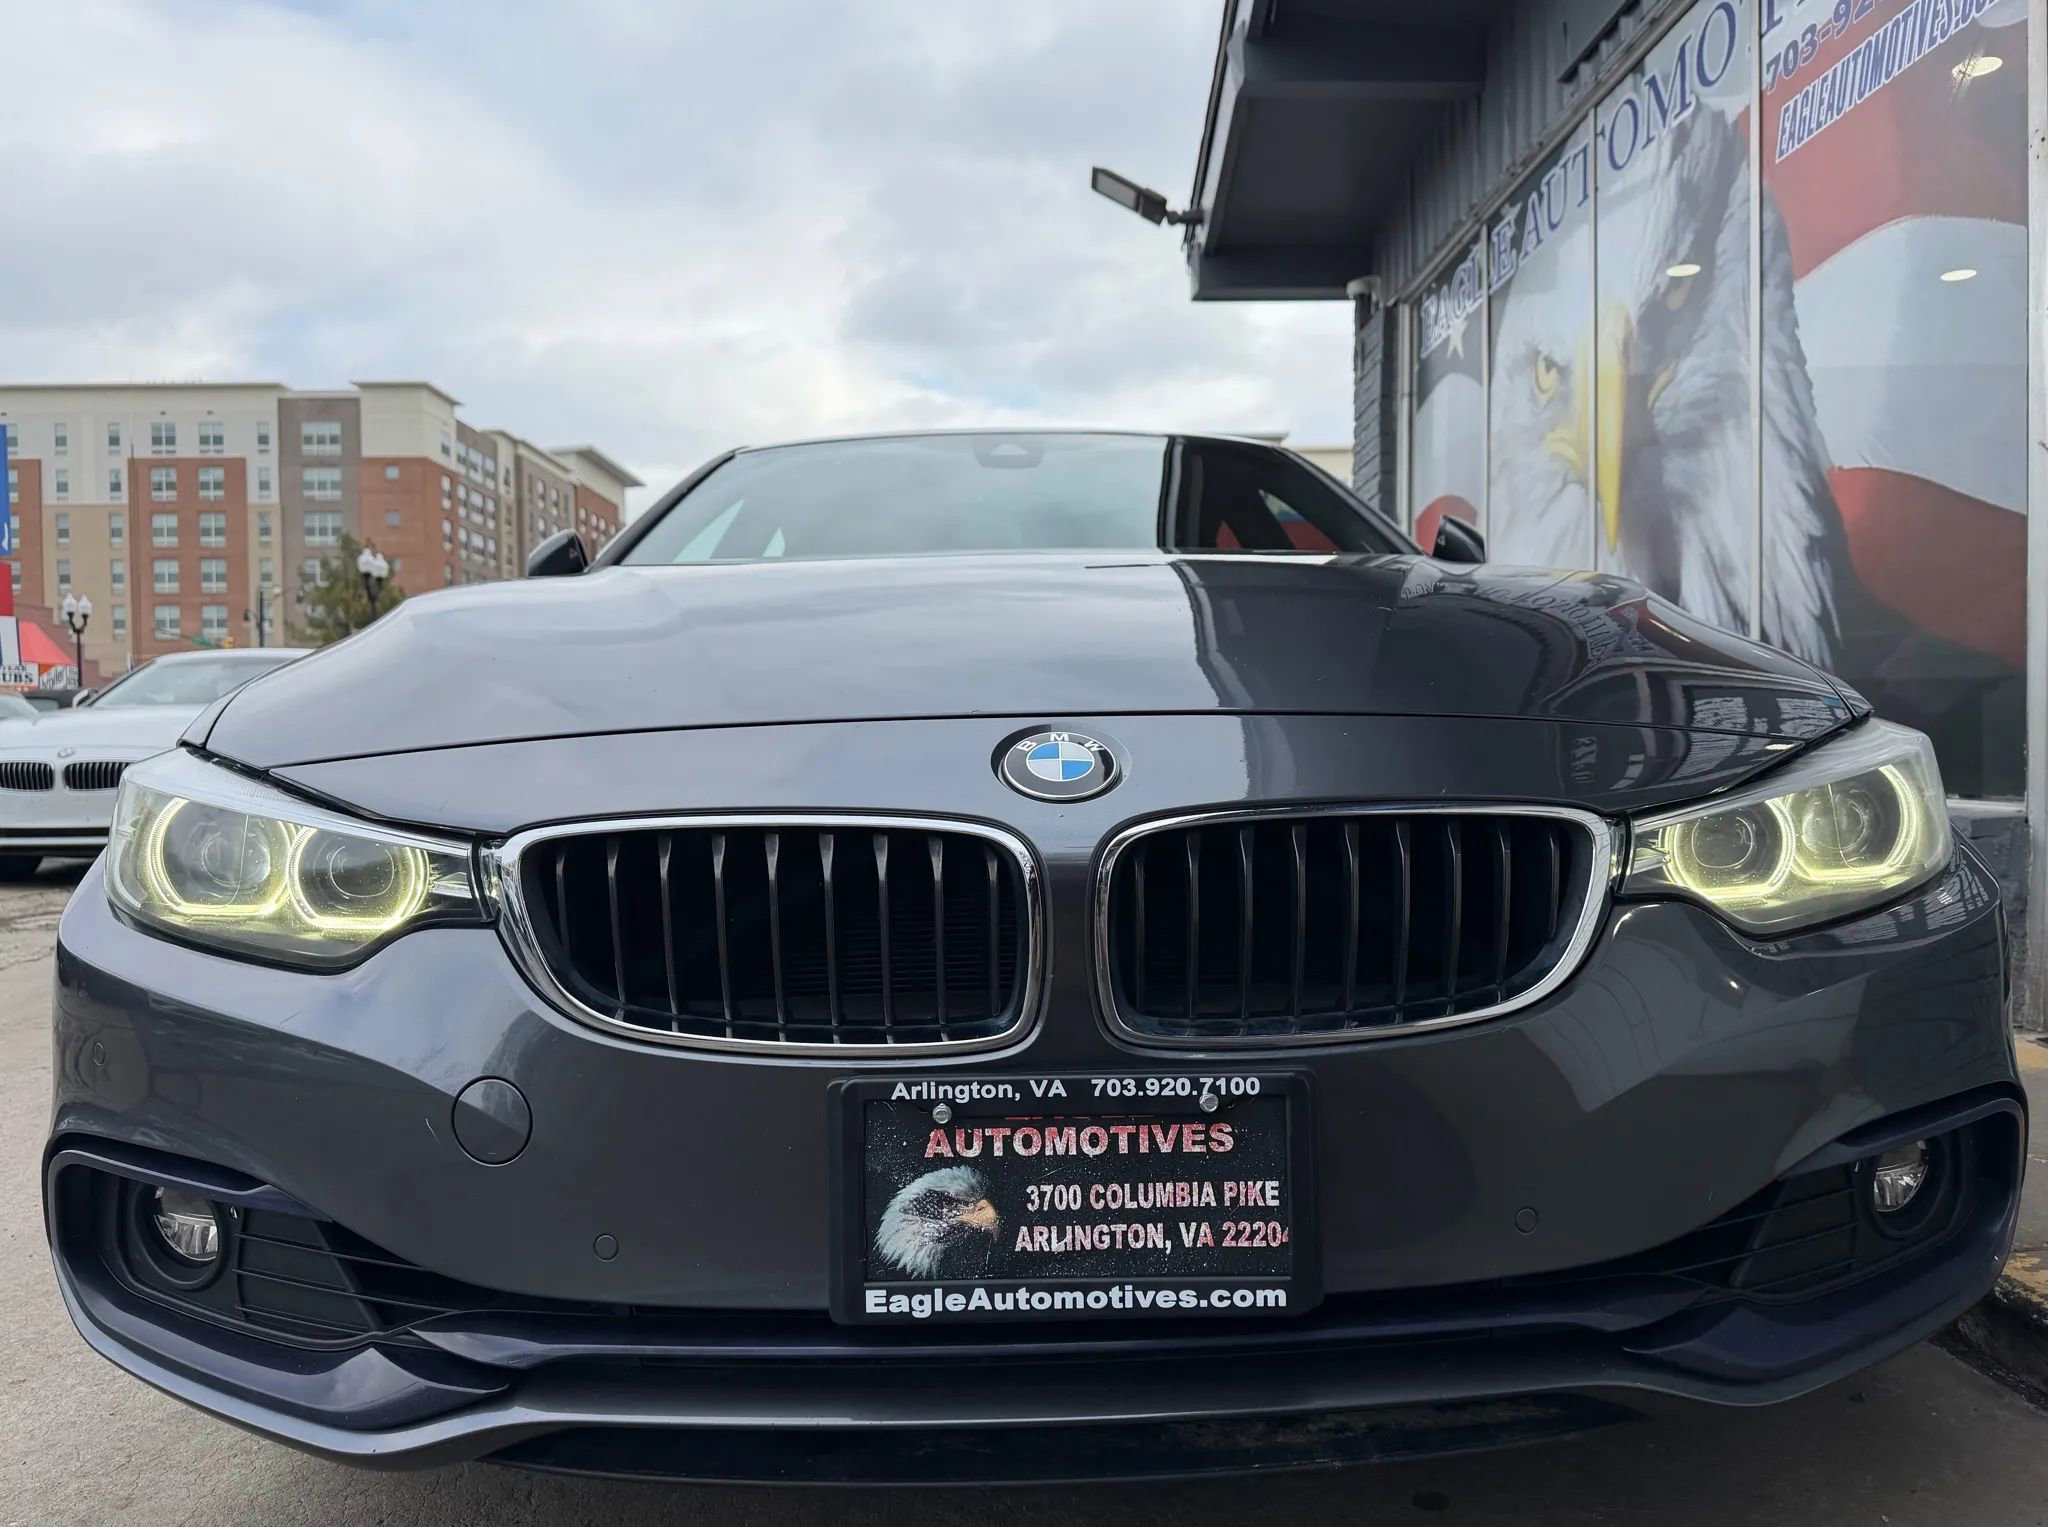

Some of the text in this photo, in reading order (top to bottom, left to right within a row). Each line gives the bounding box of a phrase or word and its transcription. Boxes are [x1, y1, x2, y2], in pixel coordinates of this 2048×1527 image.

[1421, 215, 1518, 358] EAGLE
[1016, 733, 1105, 752] BMW
[891, 1077, 1261, 1104] Arlington, VA 703.920.7100
[923, 1123, 1235, 1158] AUTOMOTIVES
[1026, 1181, 1280, 1211] 3700 COLUMBIA PIKE
[1014, 1223, 1172, 1254] ARLINGTON,
[1181, 1221, 1215, 1248] VA
[865, 1285, 1287, 1318] EagleAutomotives.com
